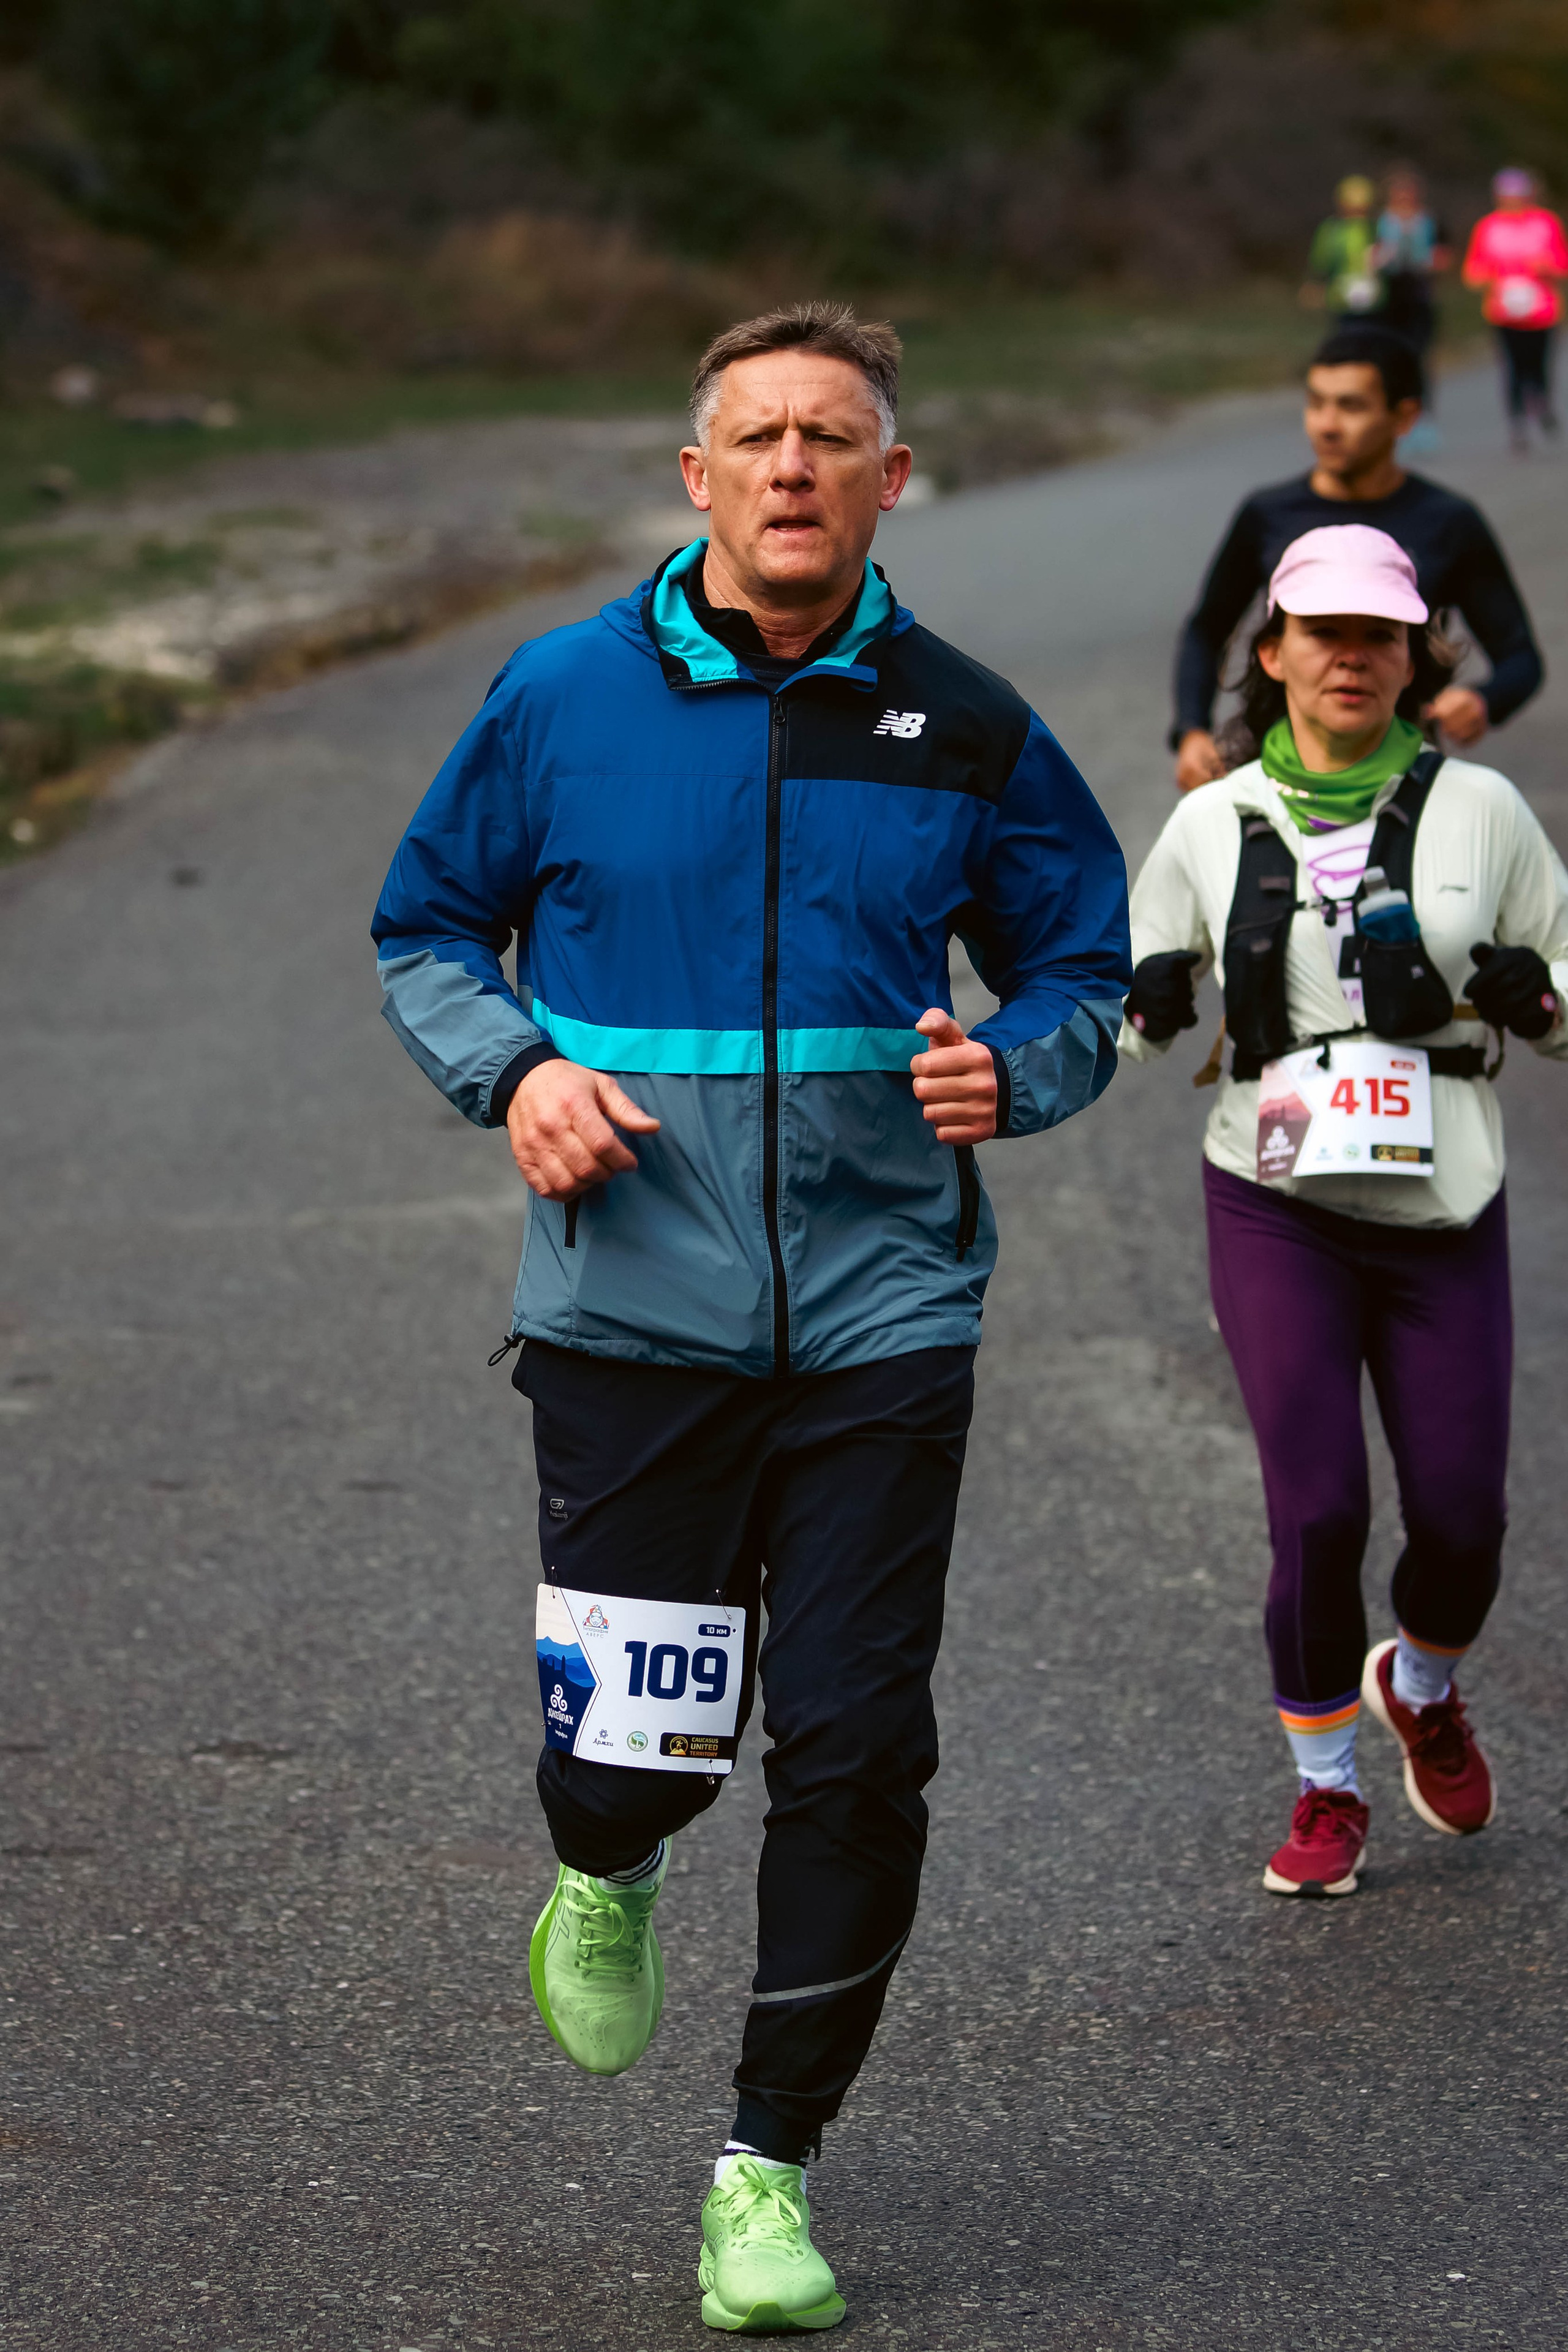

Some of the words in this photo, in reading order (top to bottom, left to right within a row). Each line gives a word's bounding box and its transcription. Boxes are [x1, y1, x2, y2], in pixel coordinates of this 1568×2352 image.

[873, 709, 926, 738] NB
[1330, 1078, 1410, 1117] 415
[624, 1640, 728, 1703] 109
